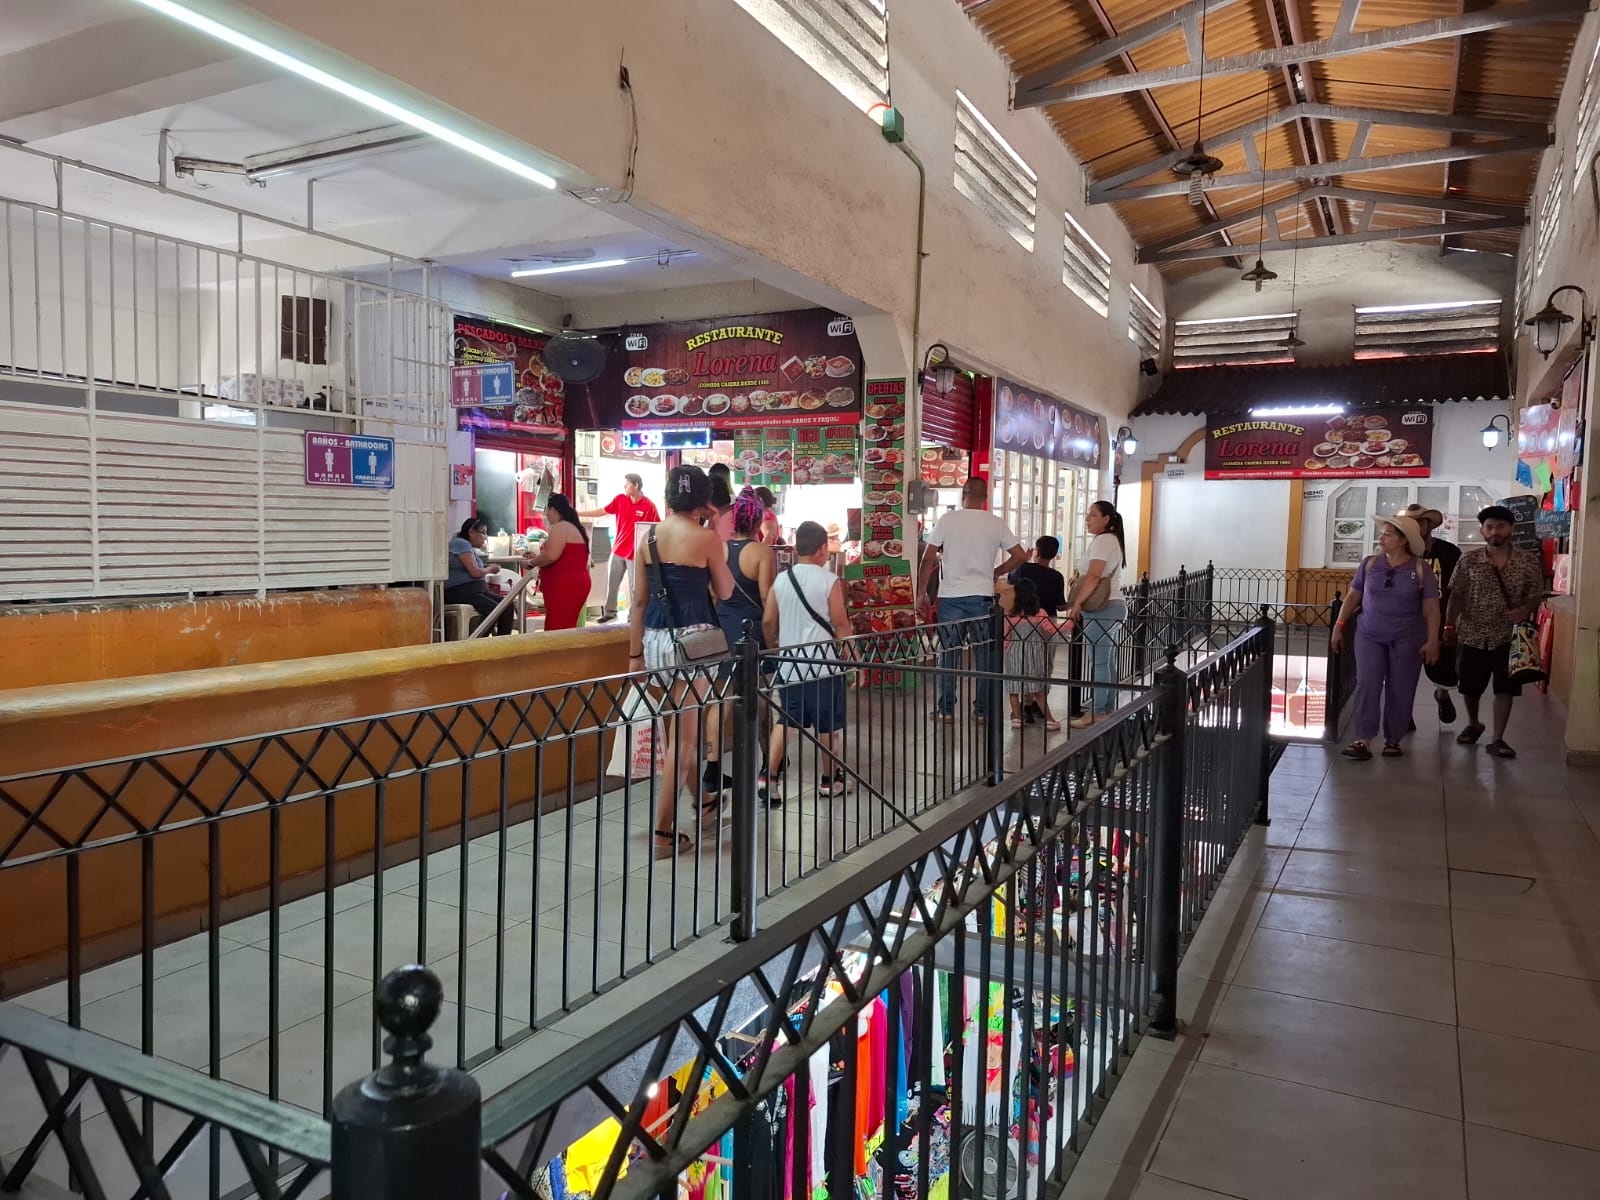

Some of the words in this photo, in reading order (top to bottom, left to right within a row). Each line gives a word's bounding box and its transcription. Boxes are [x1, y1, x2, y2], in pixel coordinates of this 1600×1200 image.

[686, 326, 784, 351] RESTAURANTE
[693, 351, 778, 376] Lorena
[868, 382, 904, 394] OFERTAS
[1212, 421, 1304, 438] RESTAURANTE
[312, 436, 338, 446] BAÑOS
[345, 440, 388, 450] BATHROOMS
[1217, 439, 1299, 458] Lorena
